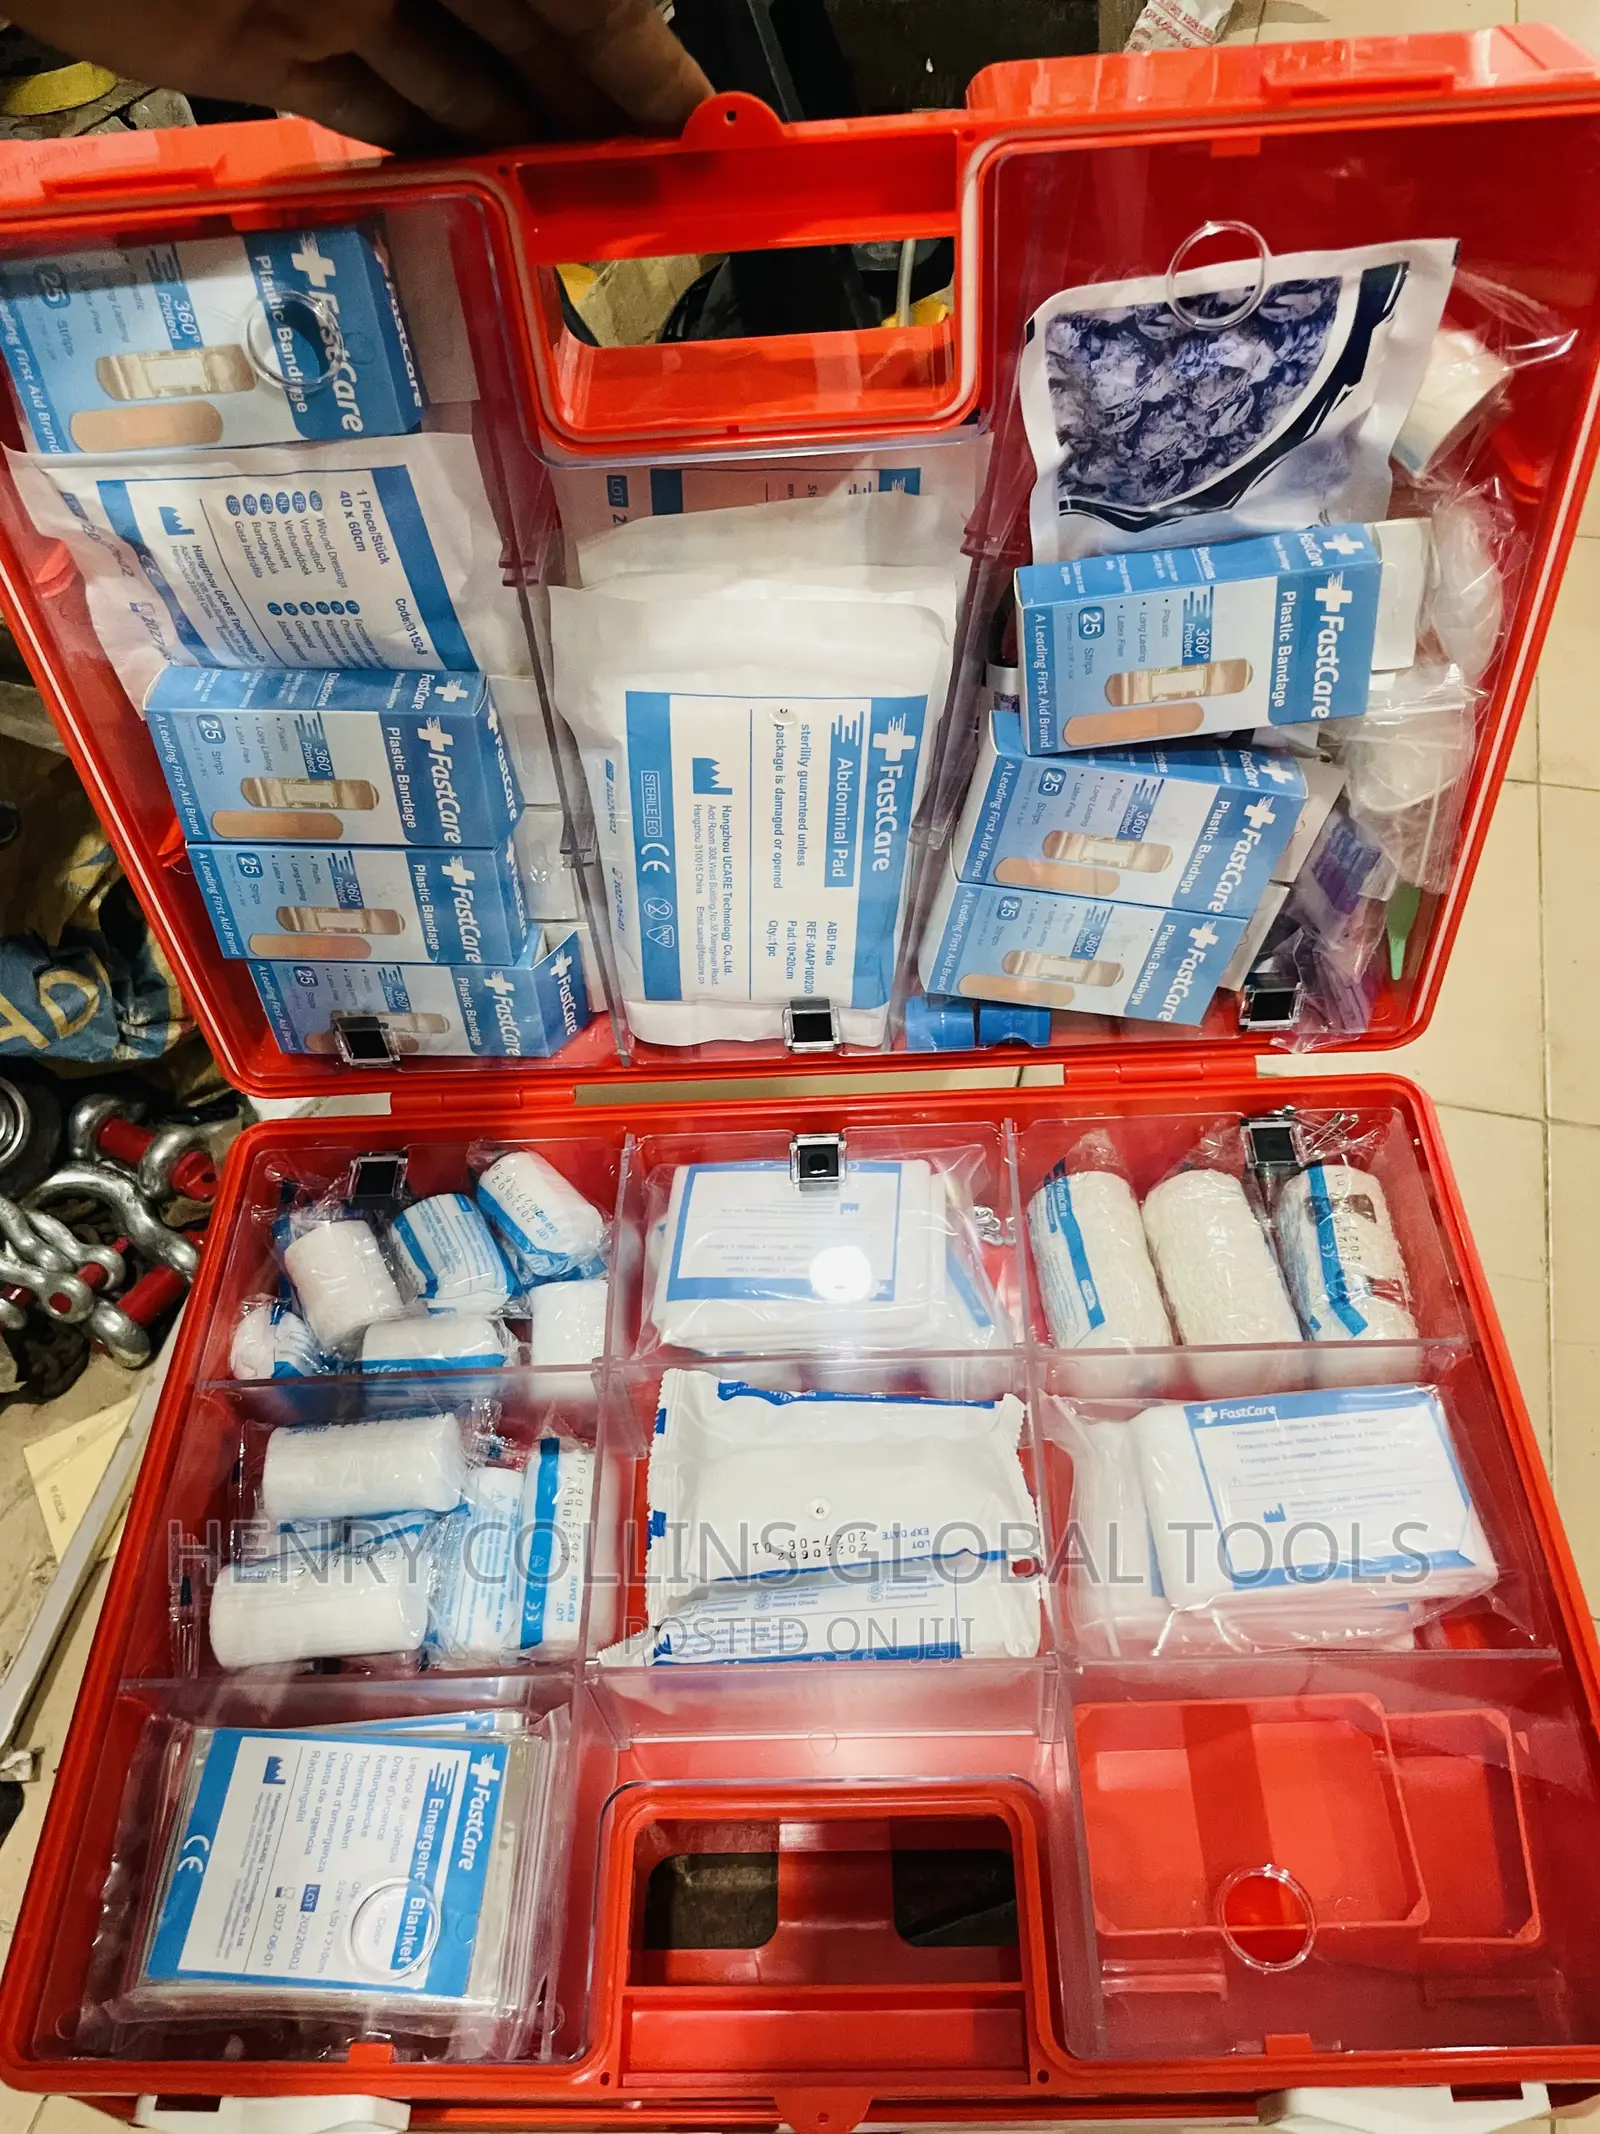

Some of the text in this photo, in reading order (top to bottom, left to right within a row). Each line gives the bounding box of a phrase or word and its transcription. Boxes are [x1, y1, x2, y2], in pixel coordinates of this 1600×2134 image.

[308, 290, 364, 432] FstCare
[15, 349, 62, 453] First Aid Brand
[228, 497, 240, 515] ES
[262, 494, 273, 514] FR
[278, 493, 290, 513] NL
[294, 493, 306, 512] DE
[609, 478, 625, 506] LOT
[316, 518, 333, 548] Wound
[339, 490, 366, 552] 40 60cm
[1279, 591, 1297, 643] Plastic
[1033, 625, 1045, 668] Leading
[1082, 613, 1100, 676] 25 Strips
[1183, 623, 1196, 659] Protect
[1196, 628, 1210, 660] 360°
[1037, 669, 1049, 692] First
[1272, 645, 1293, 708] Bandage
[1310, 615, 1345, 719] FastCare
[411, 673, 436, 710] FastCare
[1039, 693, 1049, 716] Aid
[200, 720, 222, 739] 25
[212, 751, 224, 776] Strips
[1040, 718, 1051, 749] Brand
[155, 714, 203, 836] A Leading First Aid Brand
[386, 727, 405, 771] Plastic
[396, 774, 416, 829] Bandage
[495, 737, 517, 822] FastCare
[645, 774, 657, 817] STERILE
[796, 723, 812, 867] sterility guaranteed unless
[428, 752, 462, 844] FastCare
[771, 724, 786, 889] package is damaged or opened
[831, 757, 854, 878] Abdominal Pad
[872, 765, 904, 872] FastCare
[972, 761, 1016, 878] A Leading First Aid Brand
[1032, 773, 1063, 826] 25 Strips
[1119, 804, 1138, 834] Protect
[646, 819, 659, 834] EO
[692, 804, 702, 842] Hangzhou
[720, 805, 733, 853] Hangzhou
[1131, 811, 1150, 839] 360°
[1203, 800, 1231, 841] Plastic
[201, 863, 218, 896] Leading
[239, 857, 260, 874] 25
[722, 855, 733, 890] UCARE
[1180, 844, 1212, 895] Bandage
[1207, 828, 1263, 913] FastCare
[213, 893, 224, 917] First
[334, 877, 347, 903] Protect
[413, 864, 439, 951] Plastic Bandage
[1001, 900, 1019, 917] 25
[220, 914, 232, 932] Aid
[451, 886, 482, 964] FastCare
[721, 892, 733, 942] Technology
[952, 899, 971, 932] Leading
[225, 928, 242, 956] Brand
[825, 921, 838, 966] ABD Pads
[949, 931, 963, 953] First
[297, 970, 315, 985] 25
[936, 966, 952, 992] Brand
[1131, 924, 1177, 1006] Plastic Bandage
[1157, 947, 1207, 1021] FastCare
[270, 1000, 282, 1020] First
[456, 977, 482, 1047] Plastic Bandage
[493, 997, 521, 1057] FastCare
[557, 975, 578, 1036] FastCare
[1220, 1406, 1276, 1419] FastCare
[911, 1528, 930, 1537] EXP
[912, 1540, 931, 1549] LOT
[334, 1753, 353, 1798] Coperta
[391, 1756, 404, 1782] Drap
[304, 1751, 337, 1855] Manta urgencia
[340, 1755, 370, 1849] Thermisch deken
[361, 1755, 387, 1838] Rettungsdecke
[459, 1786, 490, 1872] FastCare
[177, 1834, 210, 1873] CE
[397, 1797, 444, 1964] Emergenc Blanket
[288, 1885, 319, 1971] LOT 20220602
